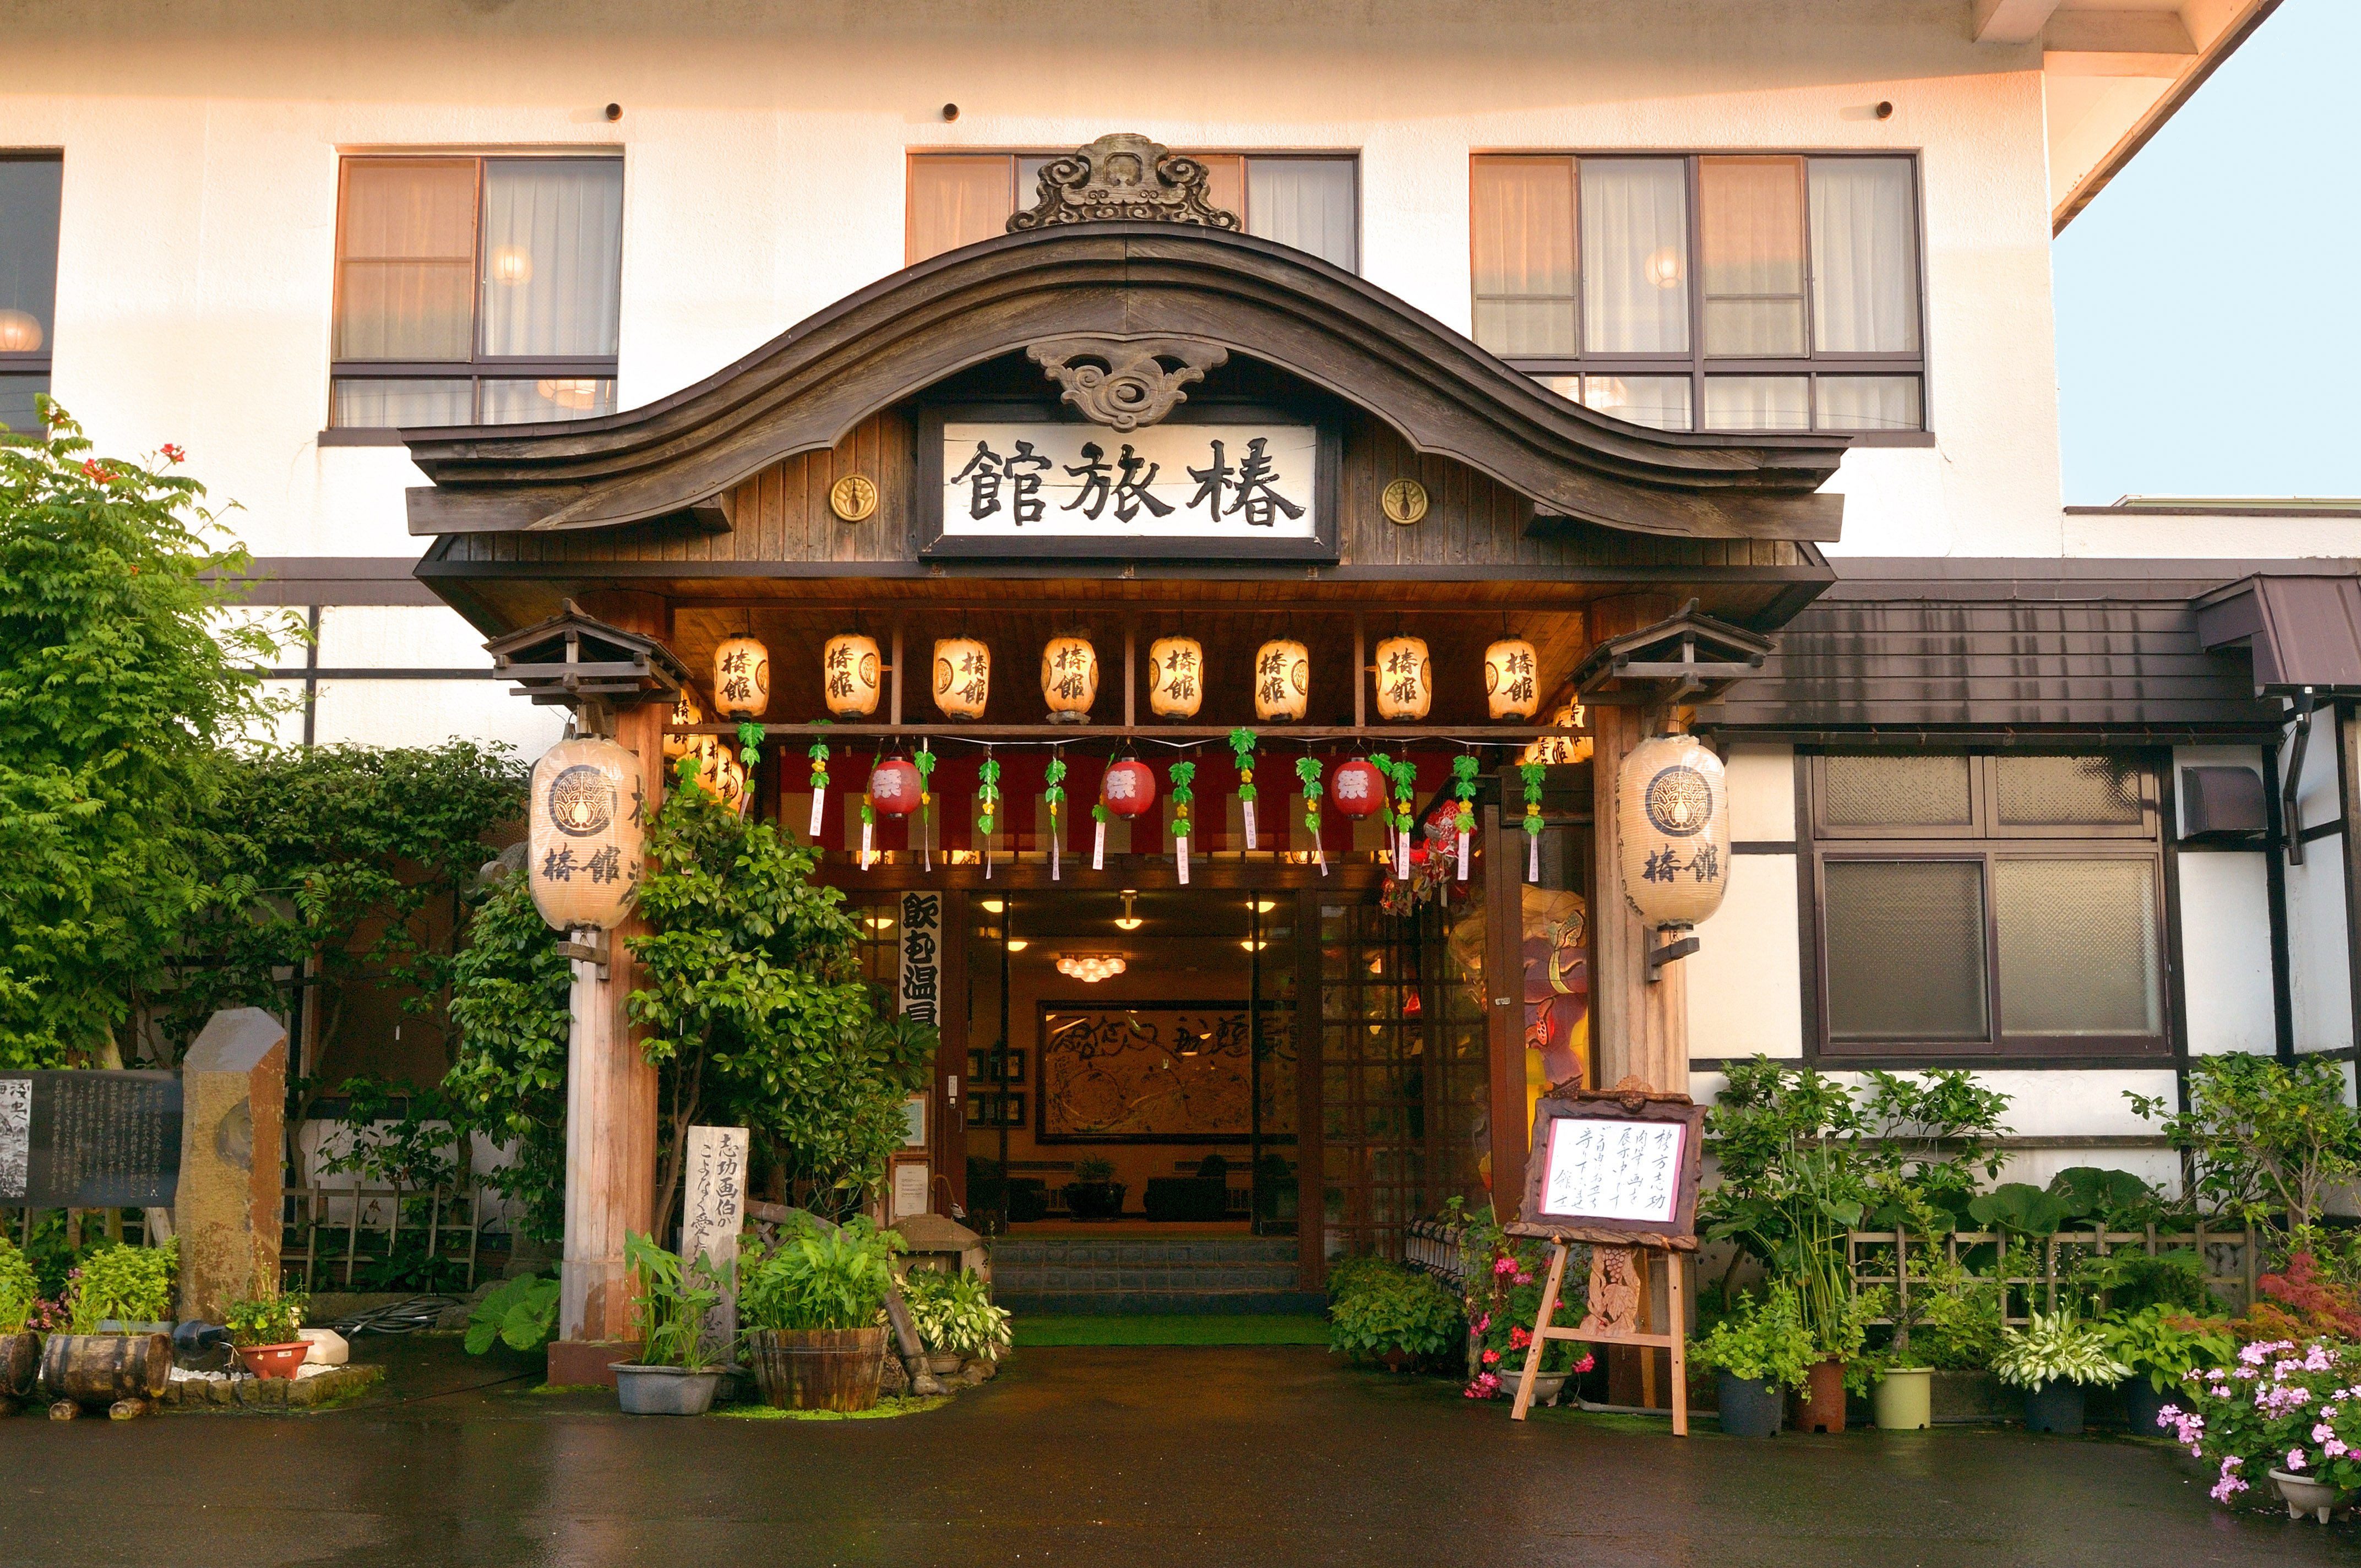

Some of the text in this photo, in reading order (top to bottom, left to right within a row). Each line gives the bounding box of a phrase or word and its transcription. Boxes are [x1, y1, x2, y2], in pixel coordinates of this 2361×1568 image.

[720, 648, 752, 702] 椿館
[827, 643, 855, 698] 椿館
[956, 650, 987, 705] 椿館
[1052, 644, 1087, 699] 椿館
[1163, 647, 1197, 700] 椿館
[1258, 649, 1287, 704] 椿館
[1385, 647, 1418, 704] 椿館
[1501, 647, 1534, 703] 椿館
[873, 769, 902, 798] 祭
[1107, 770, 1136, 799] 祭
[1337, 770, 1368, 799] 祭
[542, 842, 621, 885] 椿館
[1642, 843, 1719, 884] 椿館
[716, 1134, 739, 1227] 志功画伯が
